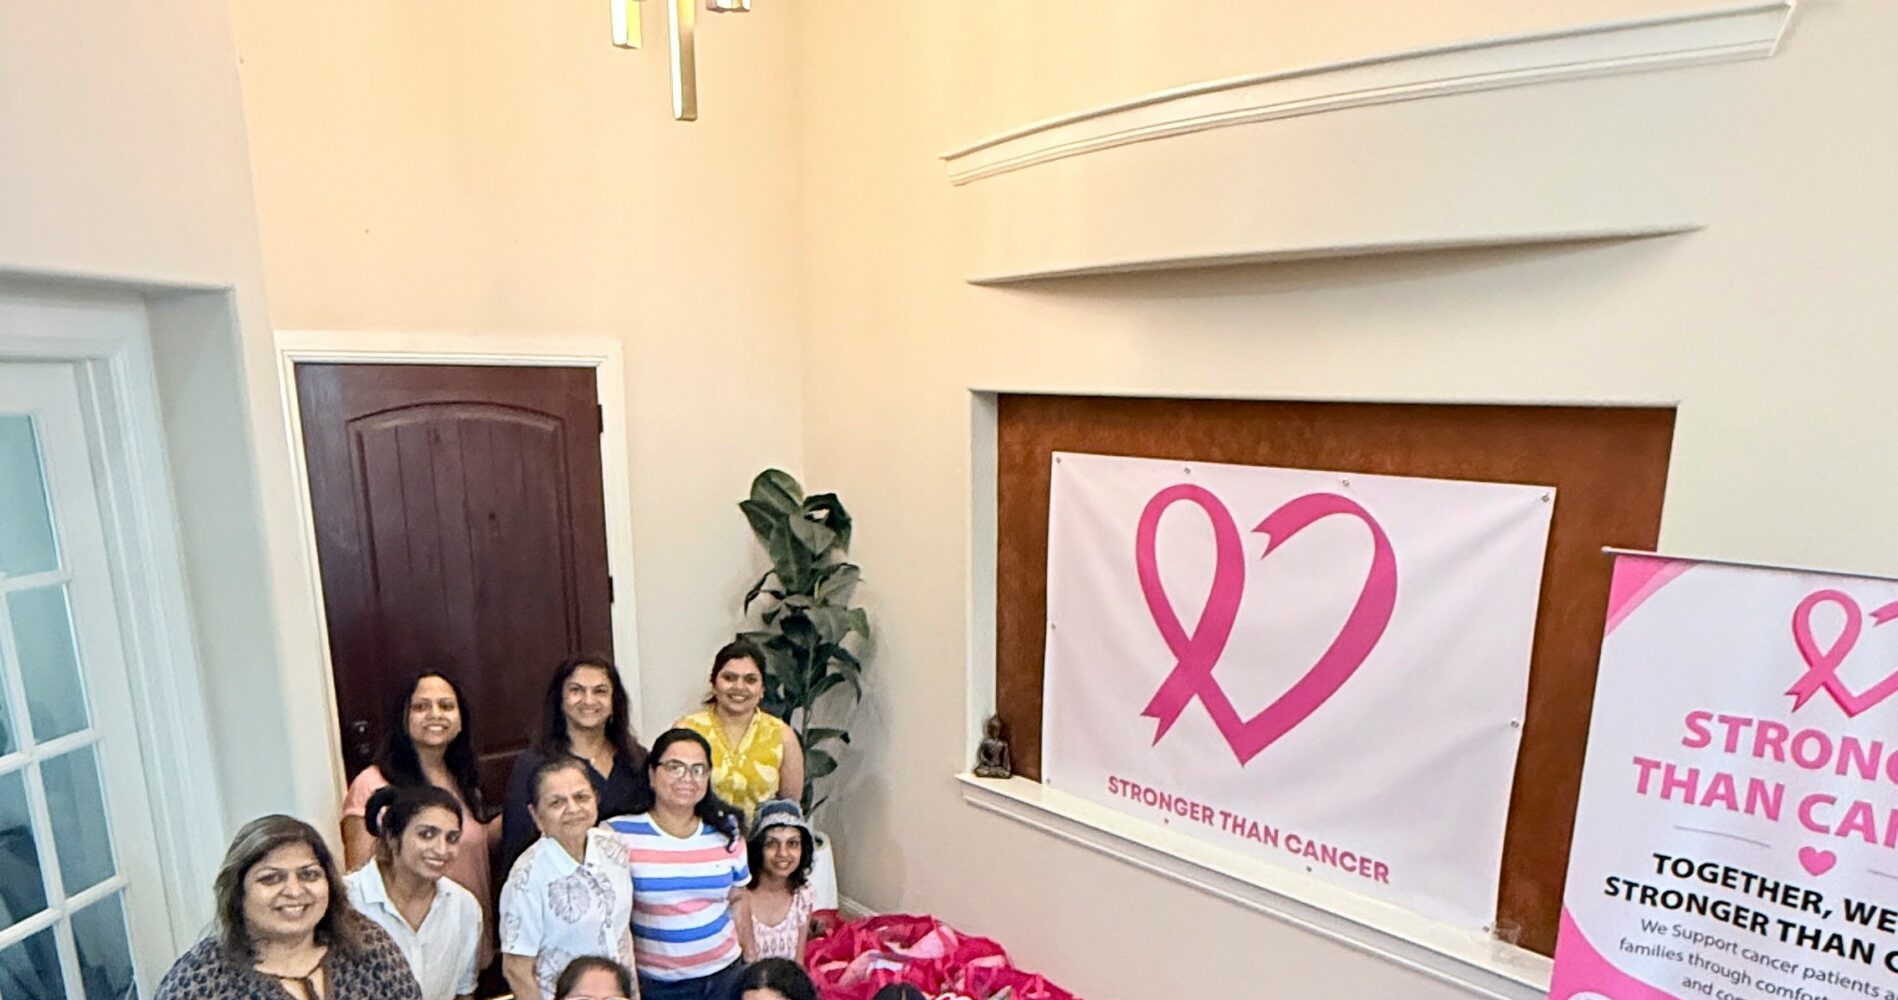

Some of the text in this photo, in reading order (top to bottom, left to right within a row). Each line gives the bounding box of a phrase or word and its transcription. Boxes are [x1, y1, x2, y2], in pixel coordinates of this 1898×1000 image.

[1633, 756, 1785, 821] THAN
[1108, 775, 1390, 884] STRONGER THAN CANCER
[1604, 876, 1770, 936] STRONGER
[1777, 918, 1876, 965] THAN
[1652, 853, 1898, 934] TOGETHER, WE
[1619, 937, 1684, 963] families
[1688, 951, 1751, 986] through
[1640, 919, 1668, 936] We
[1671, 924, 1739, 955] Support
[1741, 948, 1799, 975] cancer
[1802, 966, 1880, 998] patients
[1682, 977, 1719, 997] and
